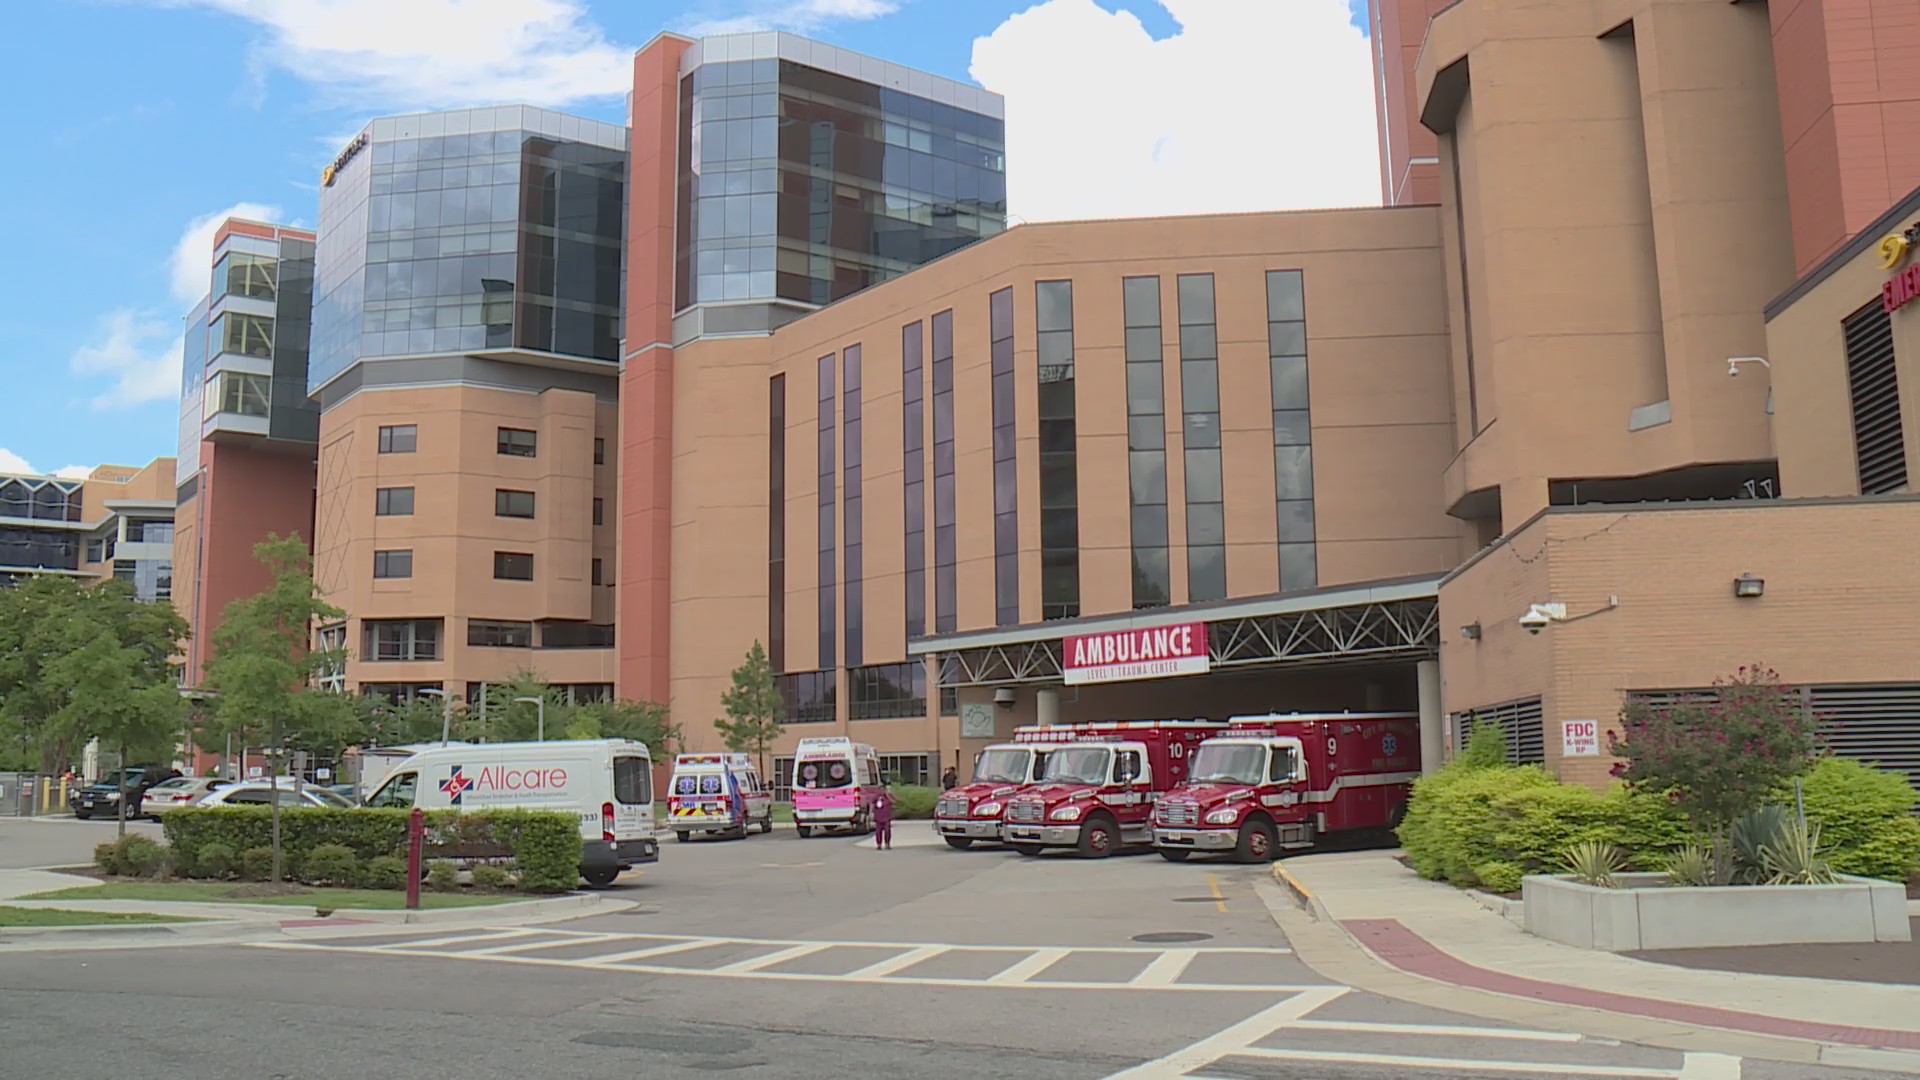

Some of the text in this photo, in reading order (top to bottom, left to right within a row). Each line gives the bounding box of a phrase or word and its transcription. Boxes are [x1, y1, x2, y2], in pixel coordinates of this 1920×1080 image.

[1074, 626, 1192, 666] AMBULANCE
[1087, 671, 1107, 680] LEVEL
[1118, 665, 1148, 677] TRAUMA
[1150, 661, 1178, 674] CENTER
[1566, 723, 1594, 737] FDC
[1168, 742, 1183, 759] 10
[1327, 737, 1337, 756] 9
[1566, 738, 1594, 746] K-WING
[476, 766, 567, 791] Allcare
